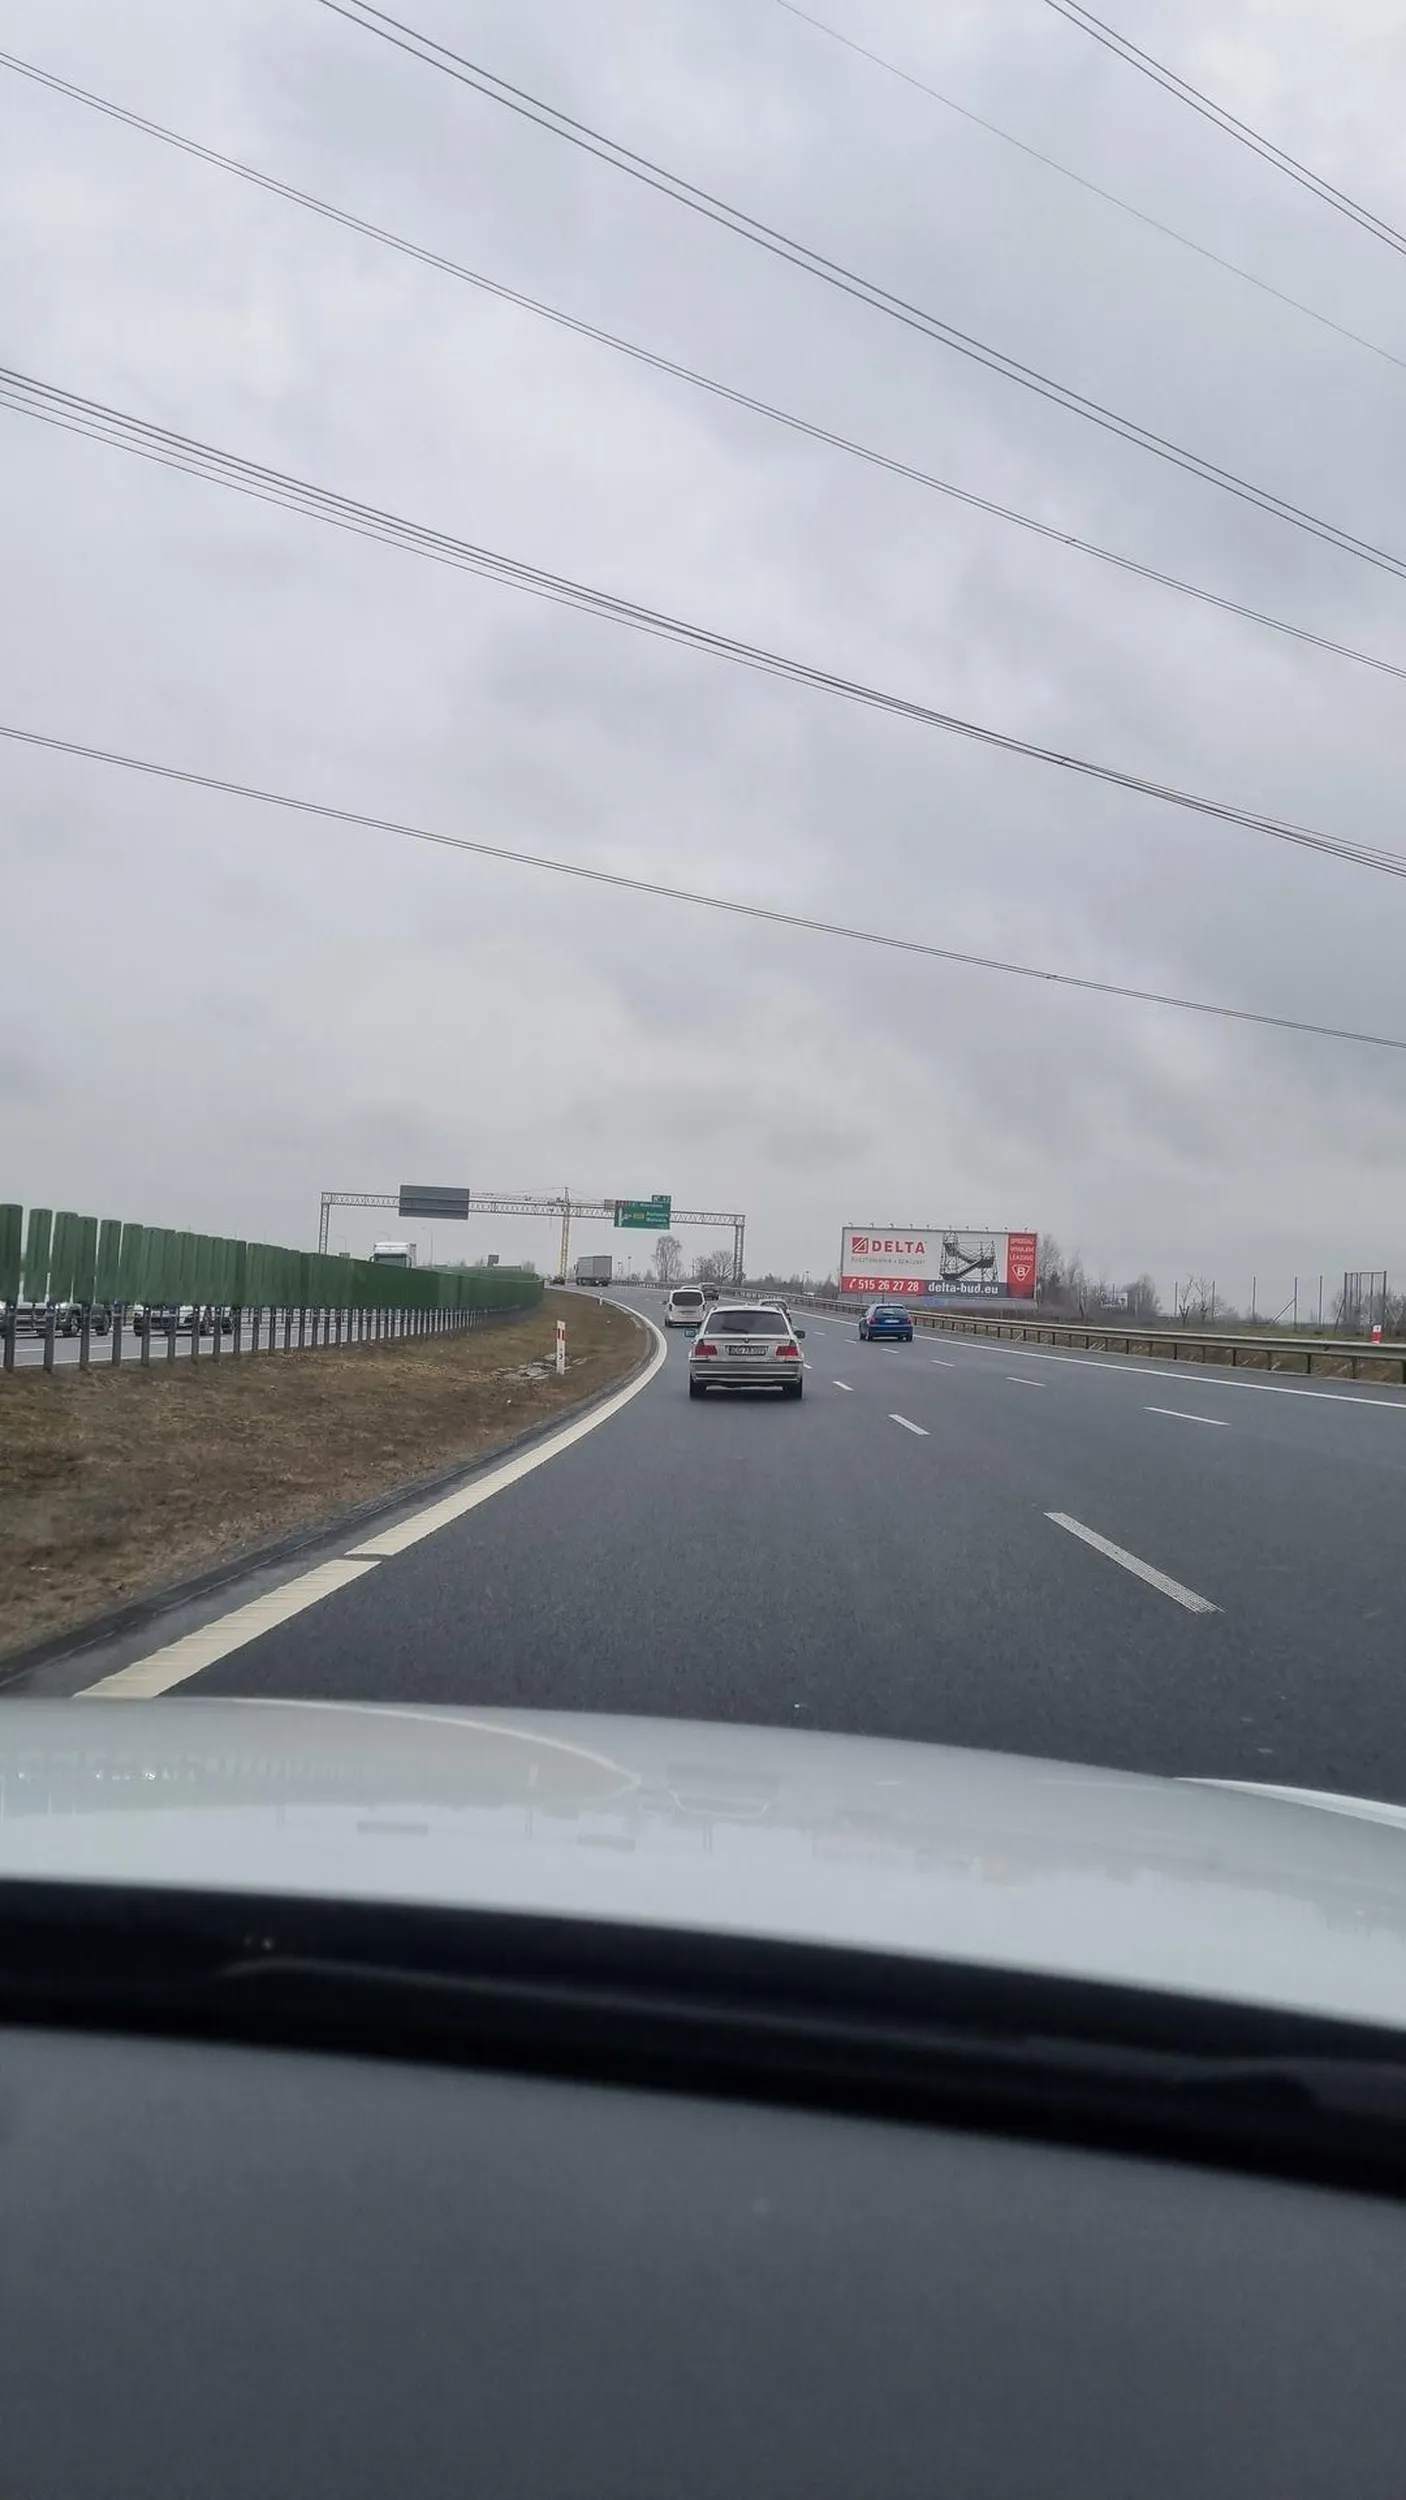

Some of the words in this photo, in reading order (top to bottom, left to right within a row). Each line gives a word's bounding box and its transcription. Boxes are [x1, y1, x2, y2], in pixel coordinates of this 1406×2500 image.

[872, 1240, 926, 1254] DELTA
[858, 1279, 876, 1290] 515
[878, 1280, 890, 1291] 26
[892, 1280, 905, 1292] 27
[907, 1281, 919, 1292] 28
[928, 1281, 999, 1294] delta-bud.eu
